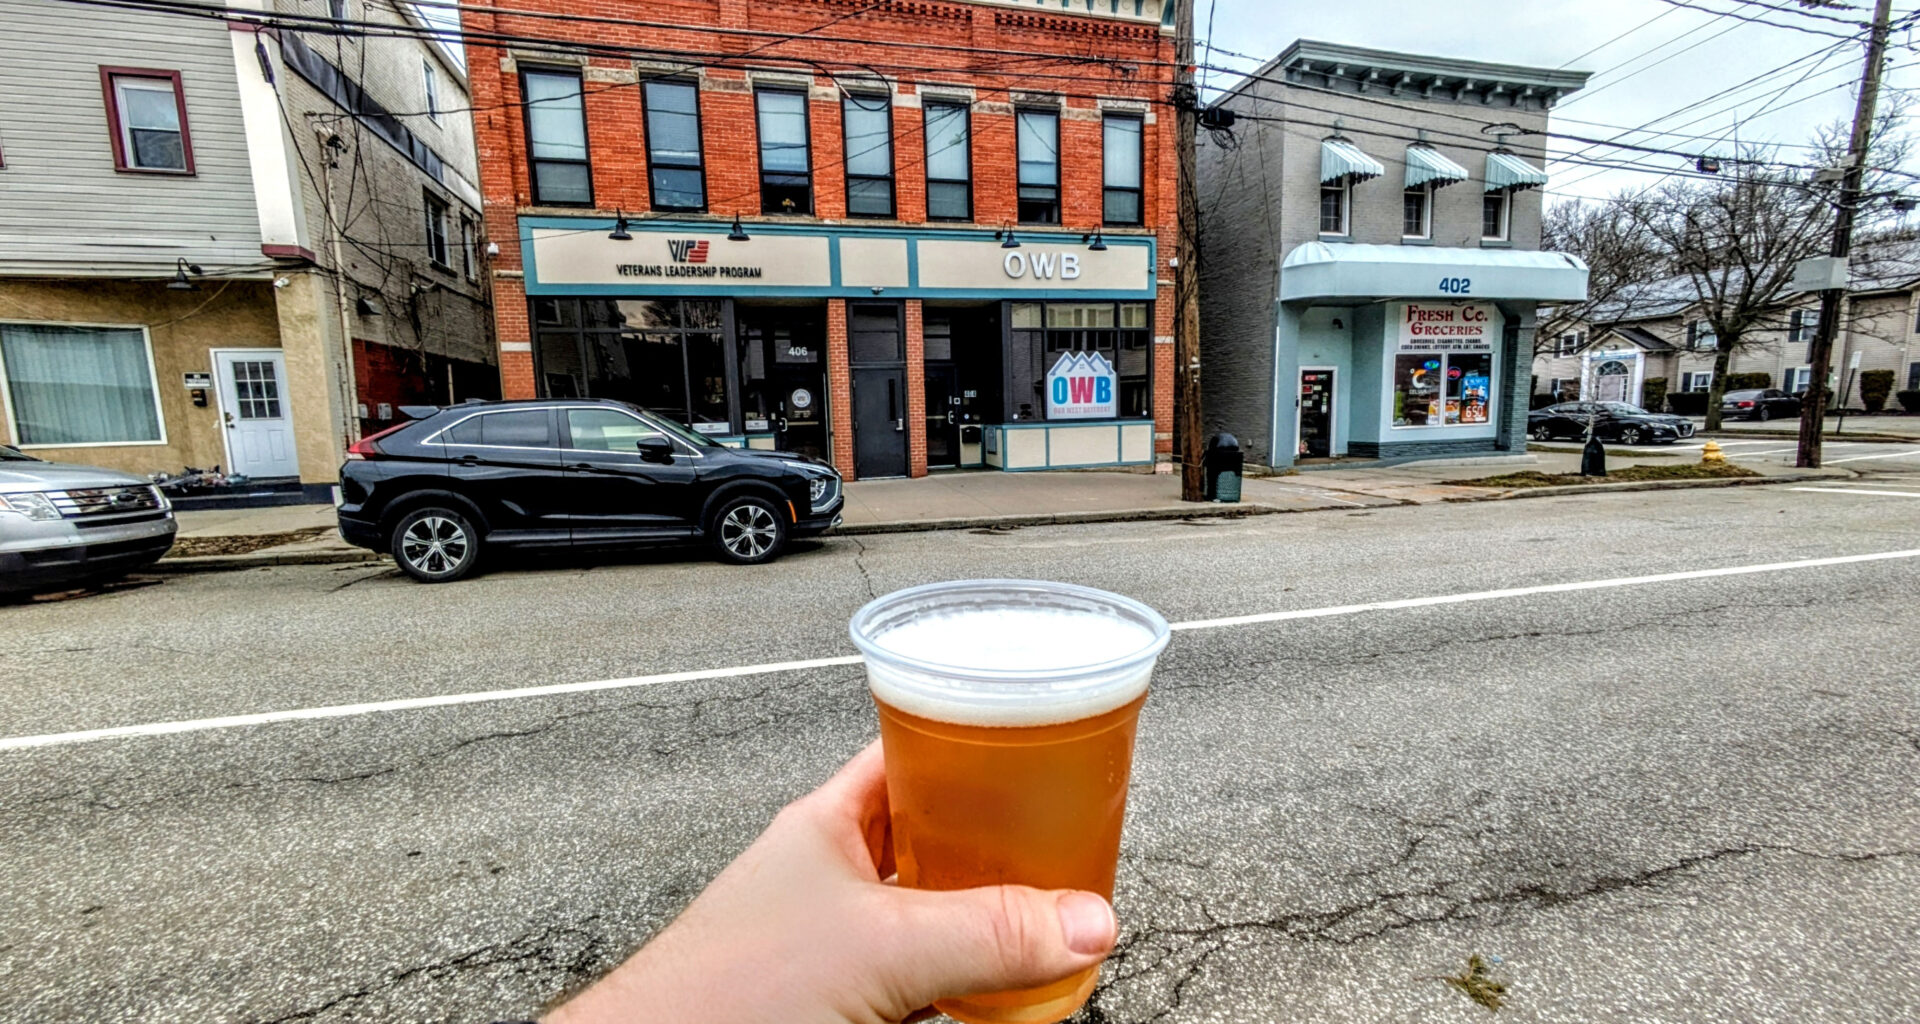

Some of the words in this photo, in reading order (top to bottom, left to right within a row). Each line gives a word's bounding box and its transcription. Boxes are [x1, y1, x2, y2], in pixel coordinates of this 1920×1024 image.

[616, 264, 662, 277] VETERANS
[665, 265, 717, 278] LEADERSHIP
[719, 267, 762, 278] PROGRAM
[1003, 251, 1081, 280] OWB
[1439, 277, 1471, 294] 402
[1406, 304, 1454, 323] FRESH
[1410, 321, 1484, 336] GROCERIES
[788, 346, 808, 356] 406
[1053, 376, 1112, 405] OWB
